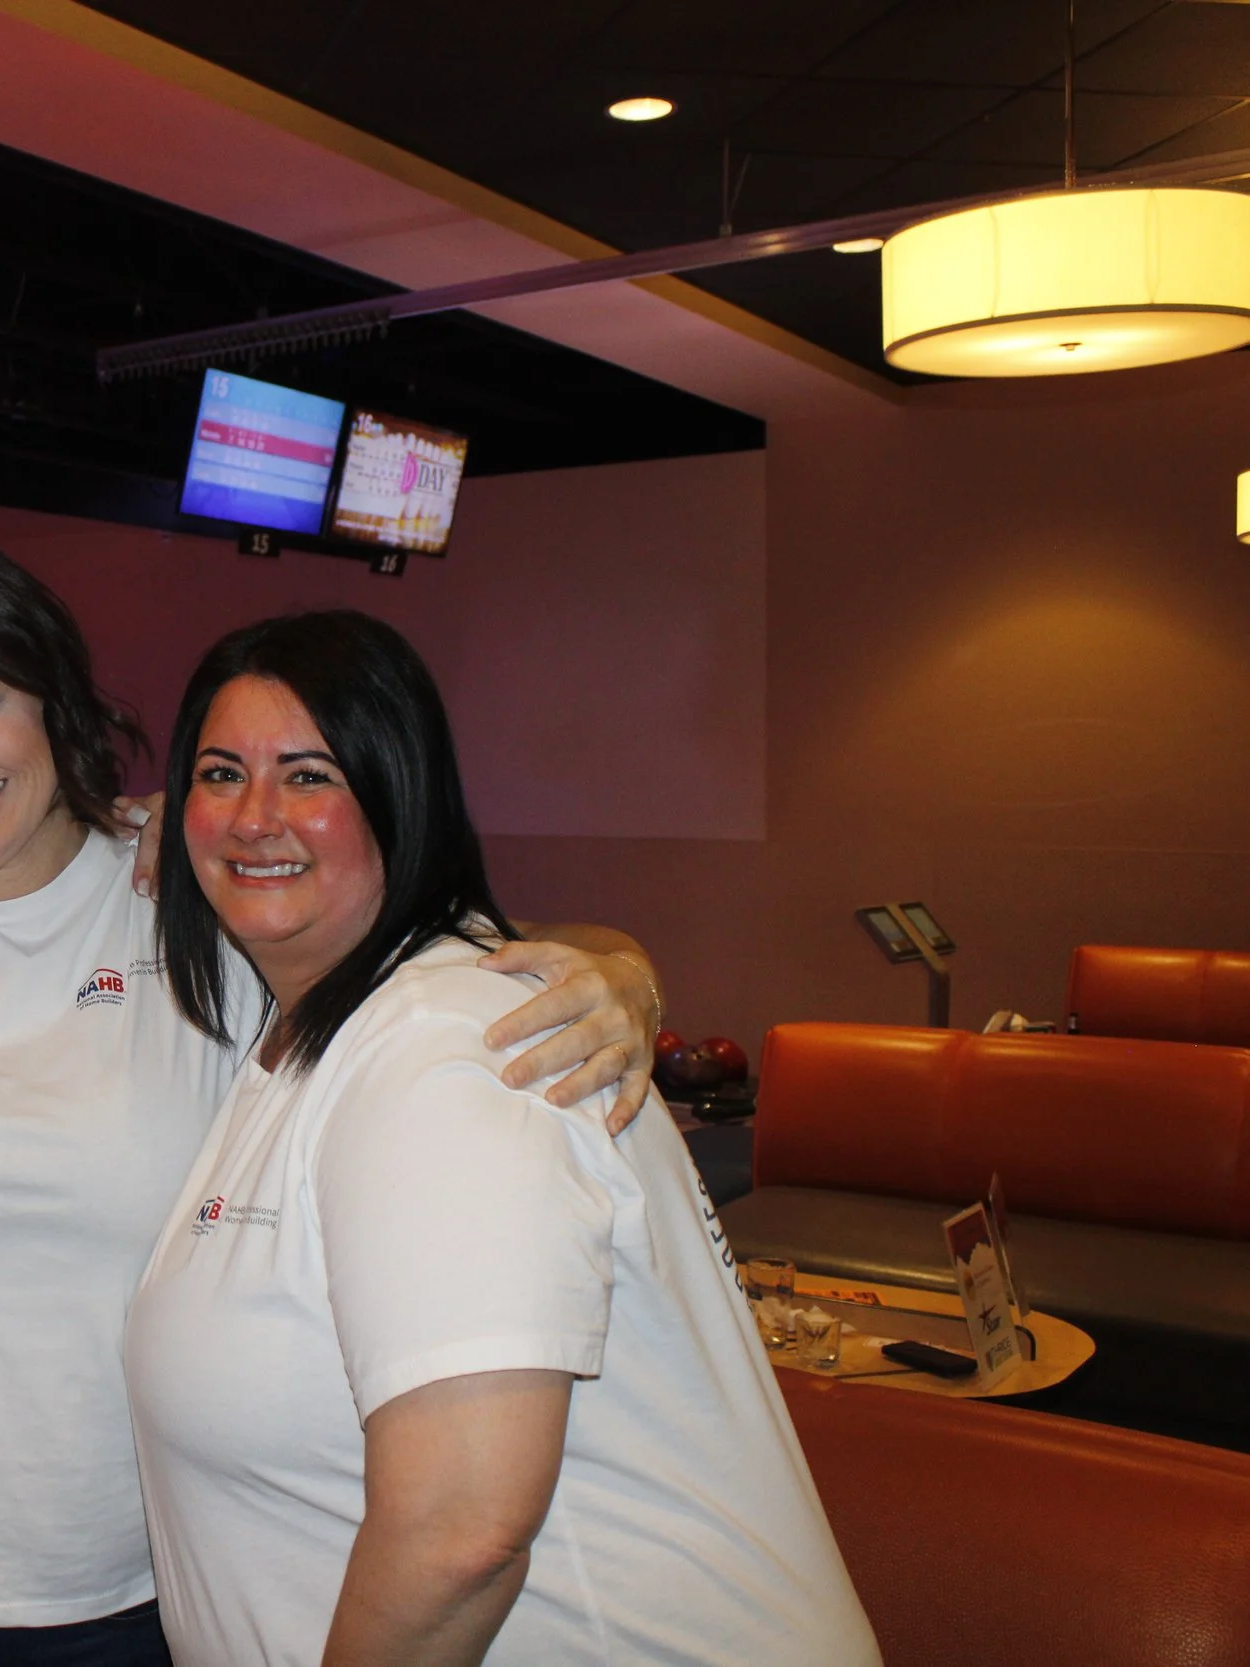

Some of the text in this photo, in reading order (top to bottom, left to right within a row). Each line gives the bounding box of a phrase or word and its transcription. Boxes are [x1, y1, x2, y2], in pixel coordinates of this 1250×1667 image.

[211, 375, 229, 399] 15
[358, 412, 373, 434] 16
[417, 464, 449, 495] DAY
[251, 534, 270, 555] 15
[380, 554, 398, 573] 16
[77, 977, 124, 1002] NAHB
